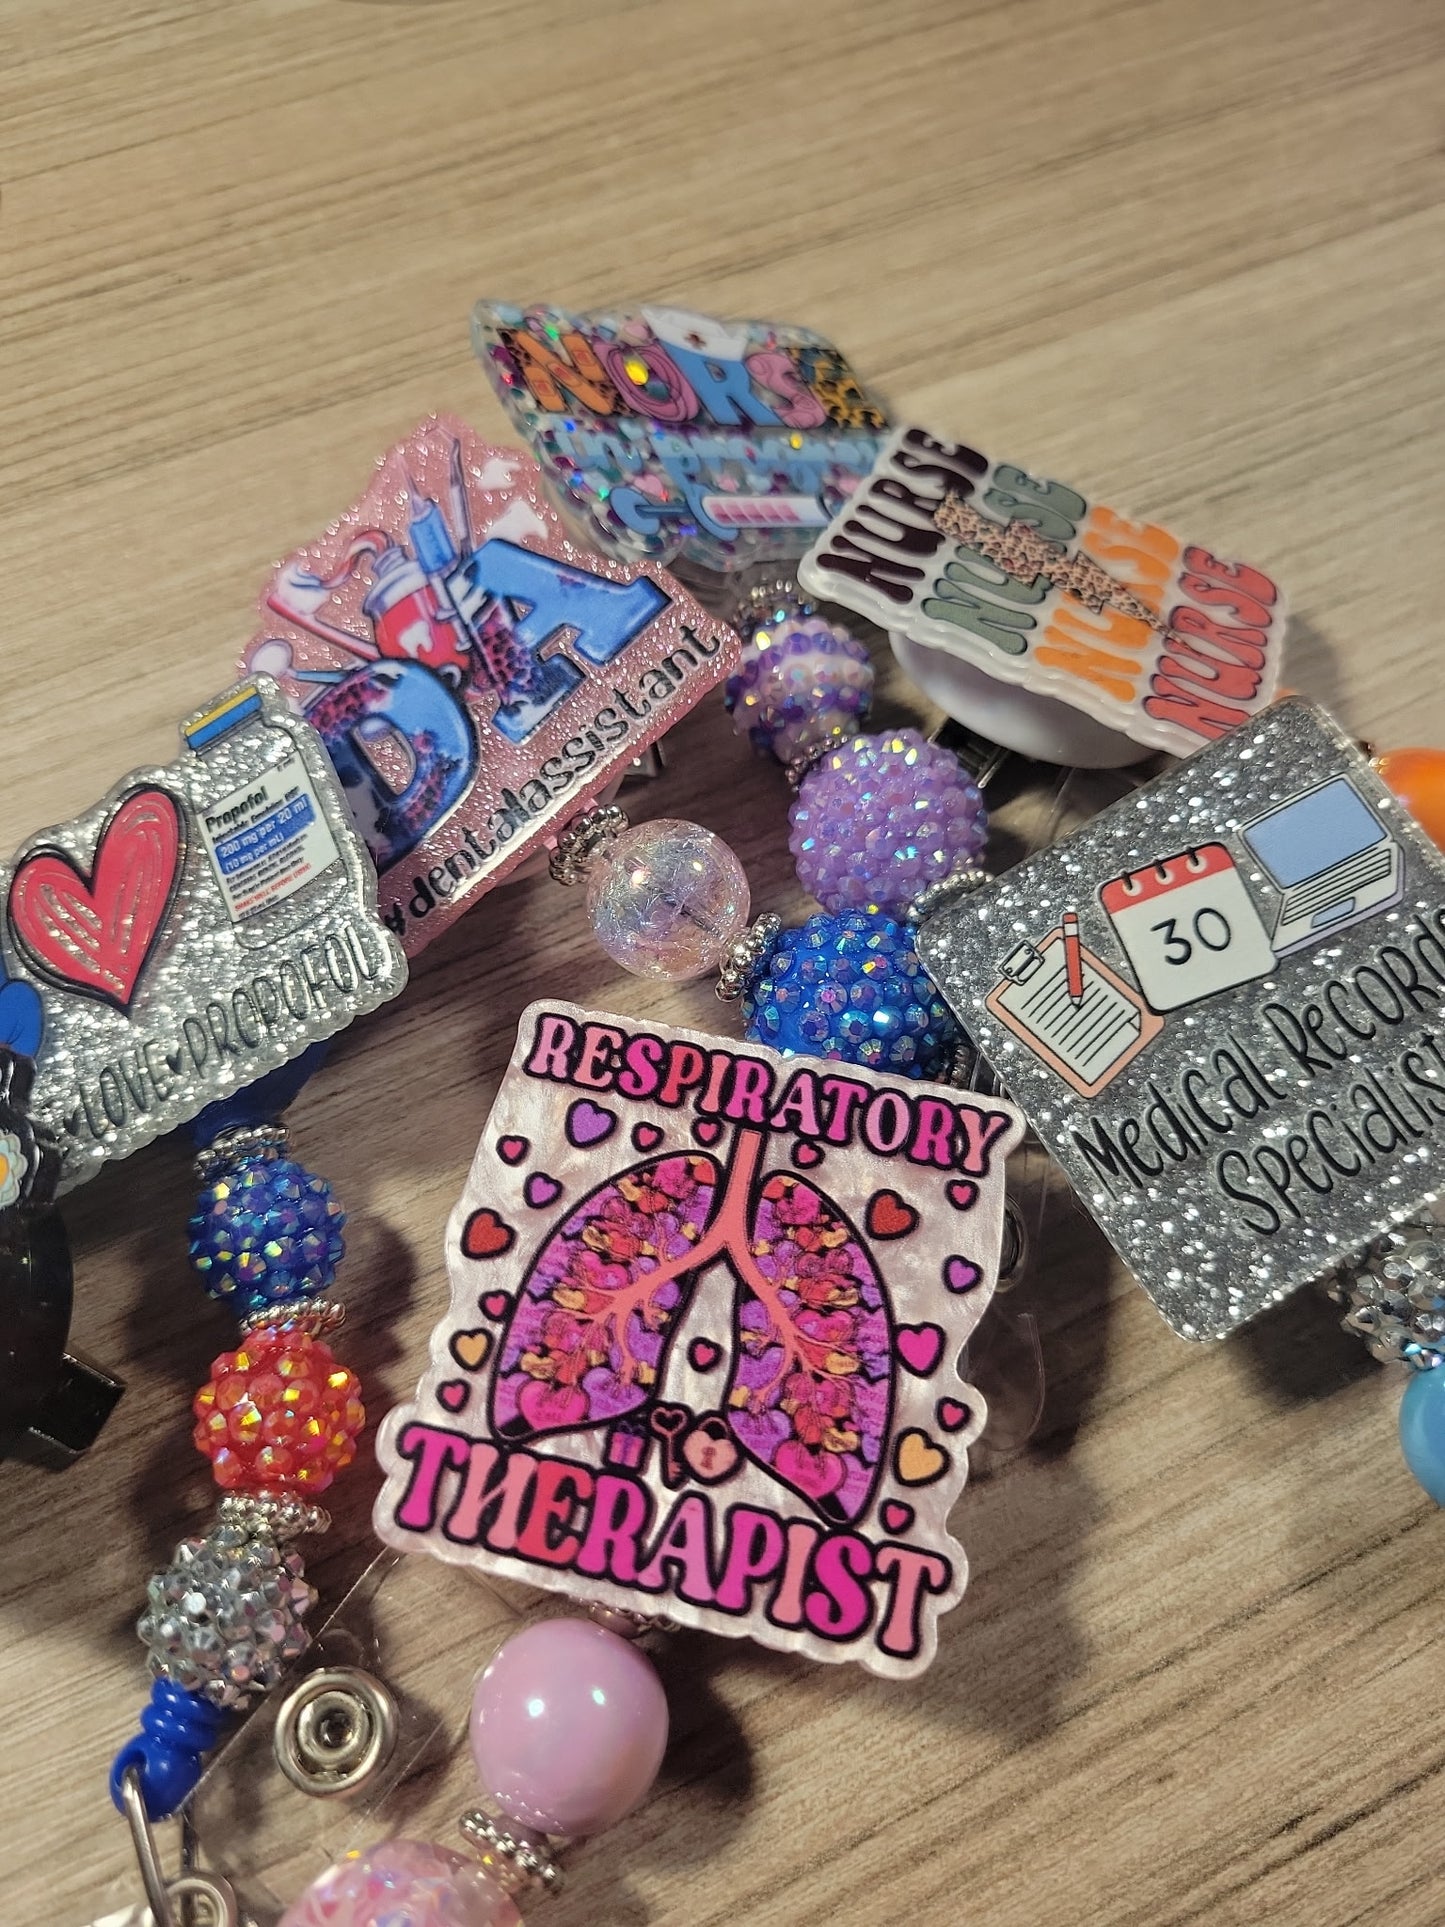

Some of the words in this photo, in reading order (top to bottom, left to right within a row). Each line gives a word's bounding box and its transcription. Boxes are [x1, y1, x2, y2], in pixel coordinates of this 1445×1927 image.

[815, 427, 989, 602] NURSE
[1142, 546, 1278, 740] NURSE
[205, 785, 269, 833] Propofol
[220, 840, 241, 859] 200
[242, 833, 258, 847] mg
[259, 820, 276, 838] per
[277, 808, 293, 824] 20
[1149, 907, 1233, 966] 30
[79, 1038, 174, 1139] LOVE
[522, 1010, 1013, 1176] RESPIRATORY
[394, 1424, 956, 1659] THERAPIST
